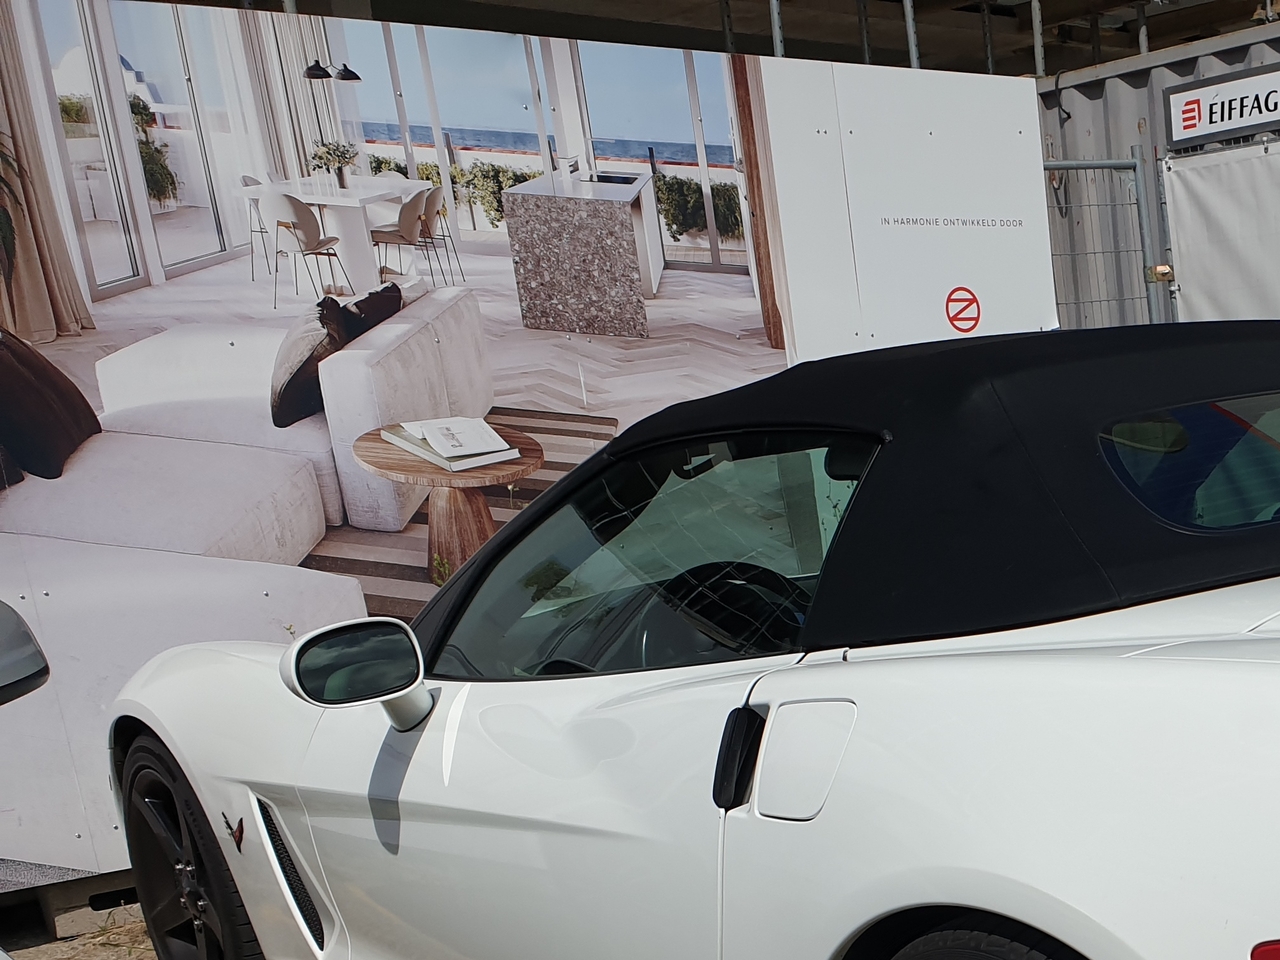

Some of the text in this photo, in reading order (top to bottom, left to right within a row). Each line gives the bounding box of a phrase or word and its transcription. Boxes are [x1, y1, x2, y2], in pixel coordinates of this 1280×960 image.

[880, 217, 1024, 227] IN HARMONIE ONTWIKKELD DOOR
